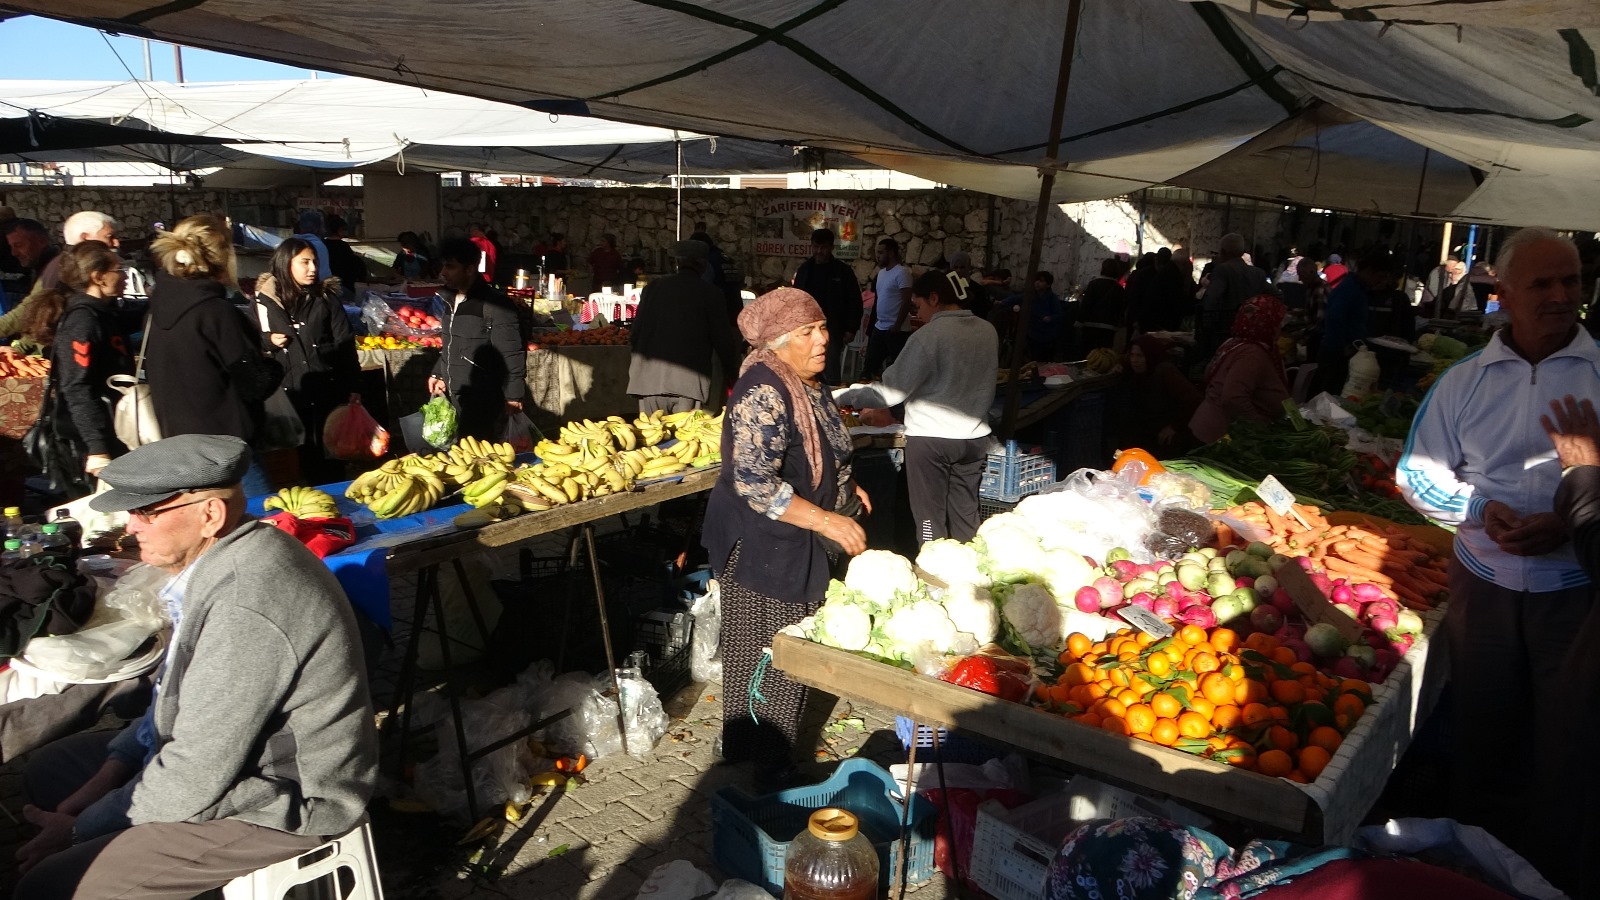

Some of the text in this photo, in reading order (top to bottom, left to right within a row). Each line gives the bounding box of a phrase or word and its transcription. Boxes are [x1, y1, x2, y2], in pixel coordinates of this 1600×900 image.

[763, 199, 860, 219] ZARİFENİN YERİ
[756, 241, 813, 256] BÖREK ÇEŞİT
